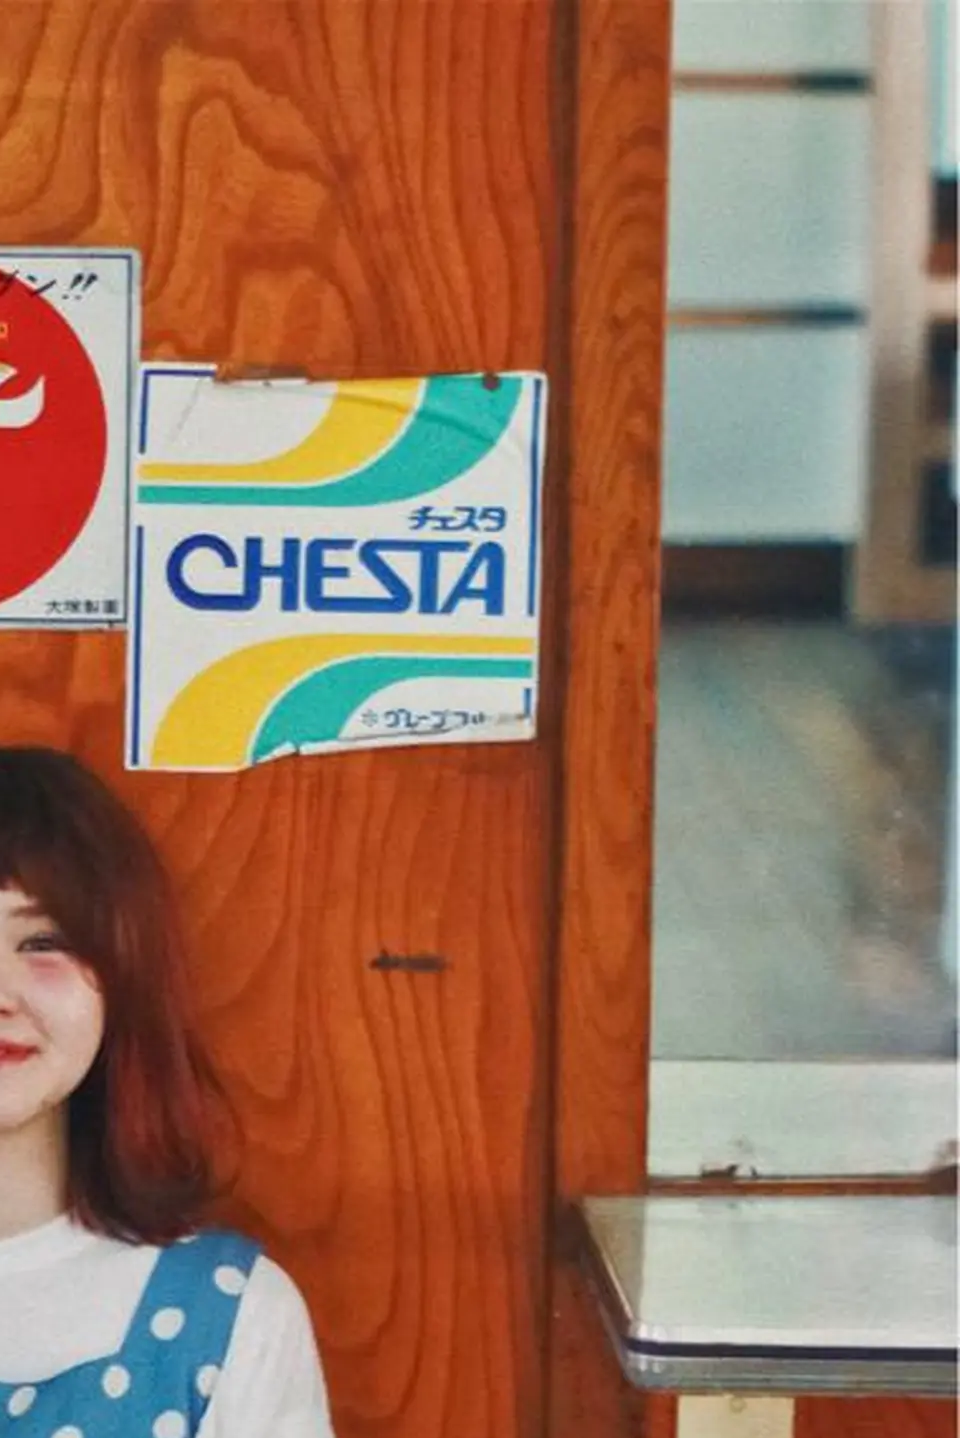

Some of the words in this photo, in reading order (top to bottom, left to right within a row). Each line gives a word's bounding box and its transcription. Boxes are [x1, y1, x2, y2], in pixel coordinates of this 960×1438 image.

[408, 506, 506, 531] チェスタ
[166, 533, 506, 615] CHESTA
